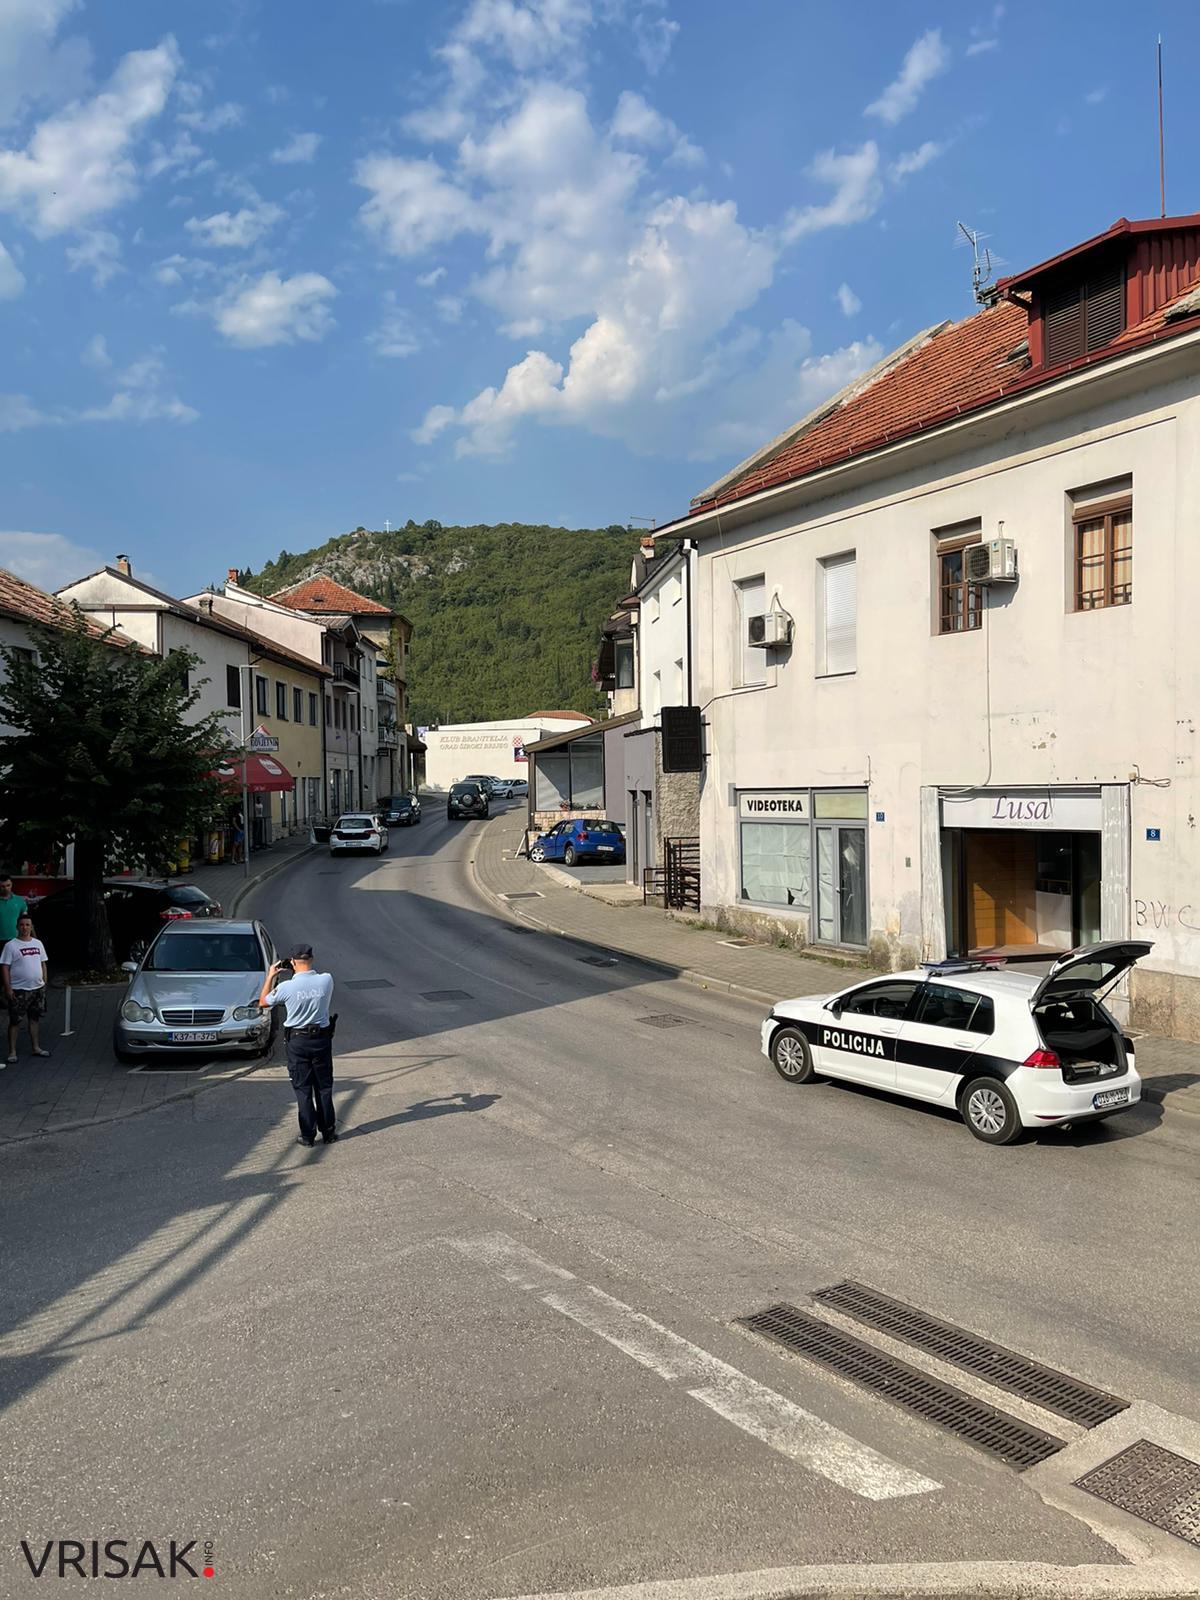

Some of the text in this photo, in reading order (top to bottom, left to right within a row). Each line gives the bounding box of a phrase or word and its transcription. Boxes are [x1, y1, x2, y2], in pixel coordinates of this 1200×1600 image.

[747, 800, 803, 811] VIDEOTEKA
[992, 795, 1050, 820] Lusa
[173, 1032, 216, 1041] K37-T-375
[823, 1029, 885, 1056] POLICIJA
